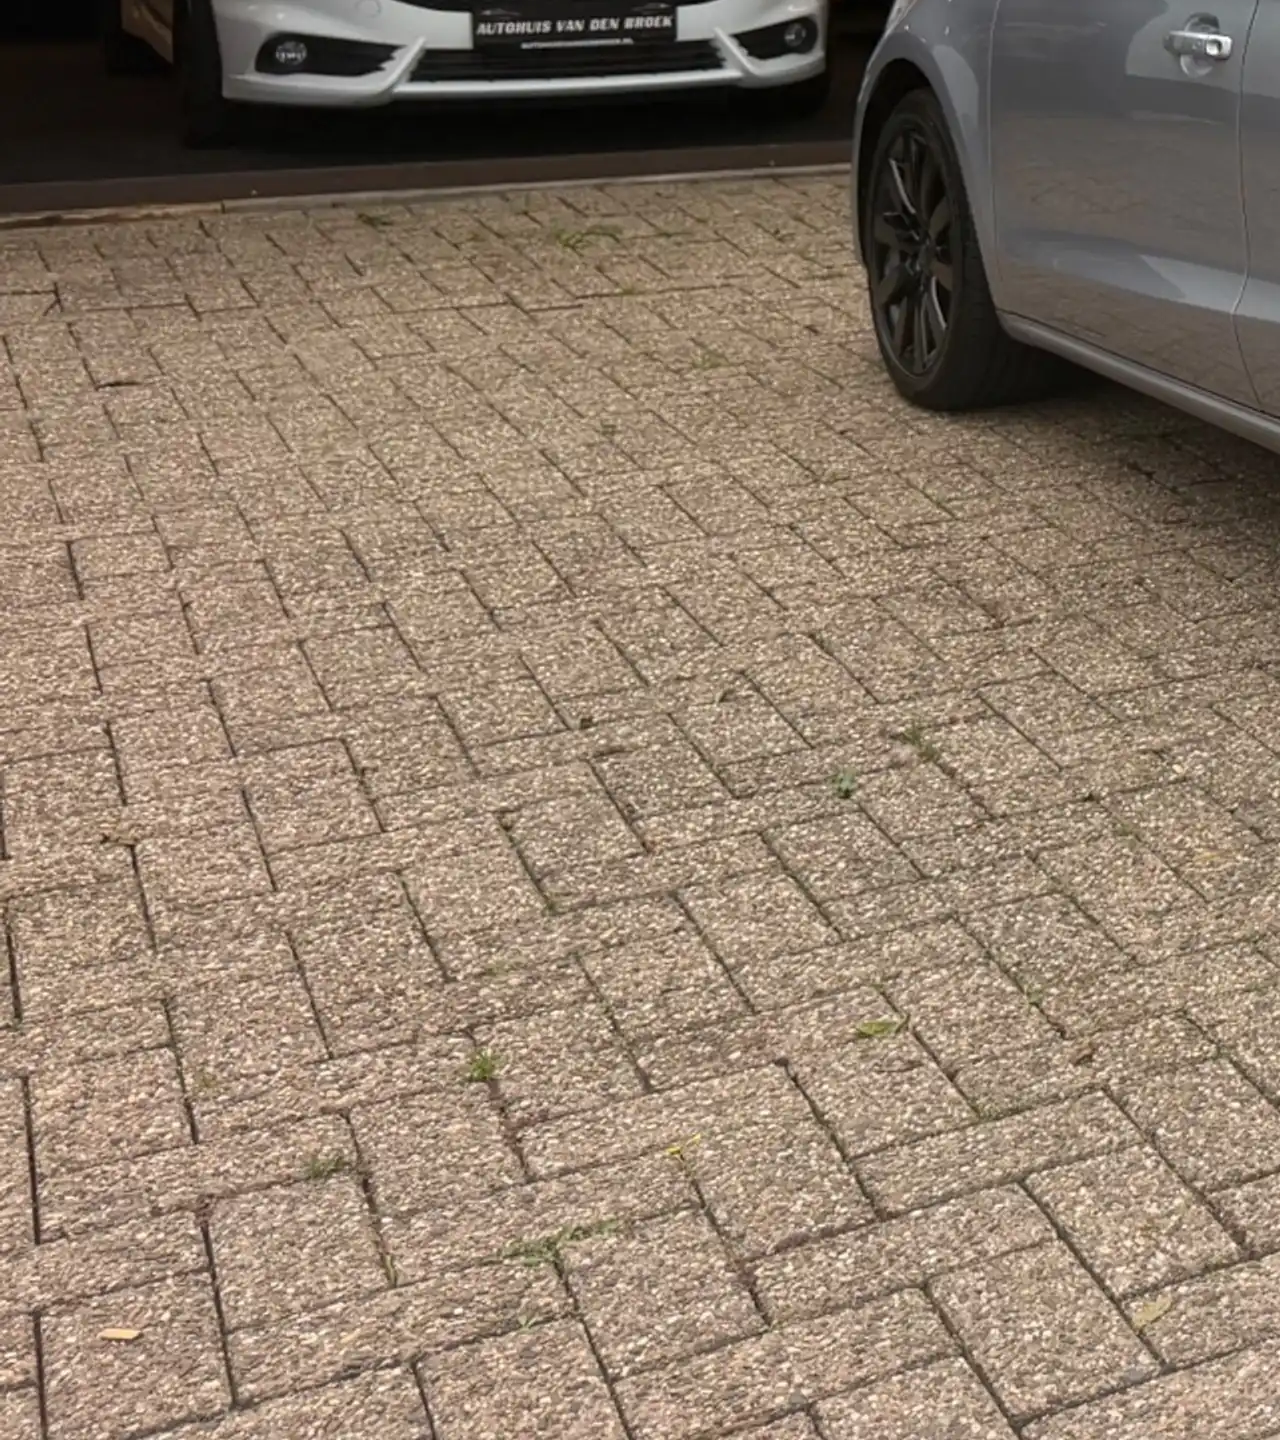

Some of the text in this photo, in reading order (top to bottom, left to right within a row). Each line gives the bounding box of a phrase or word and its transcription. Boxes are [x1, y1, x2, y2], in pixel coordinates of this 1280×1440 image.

[476, 14, 674, 36] AUTOHUIS VAN DEN BROEK
